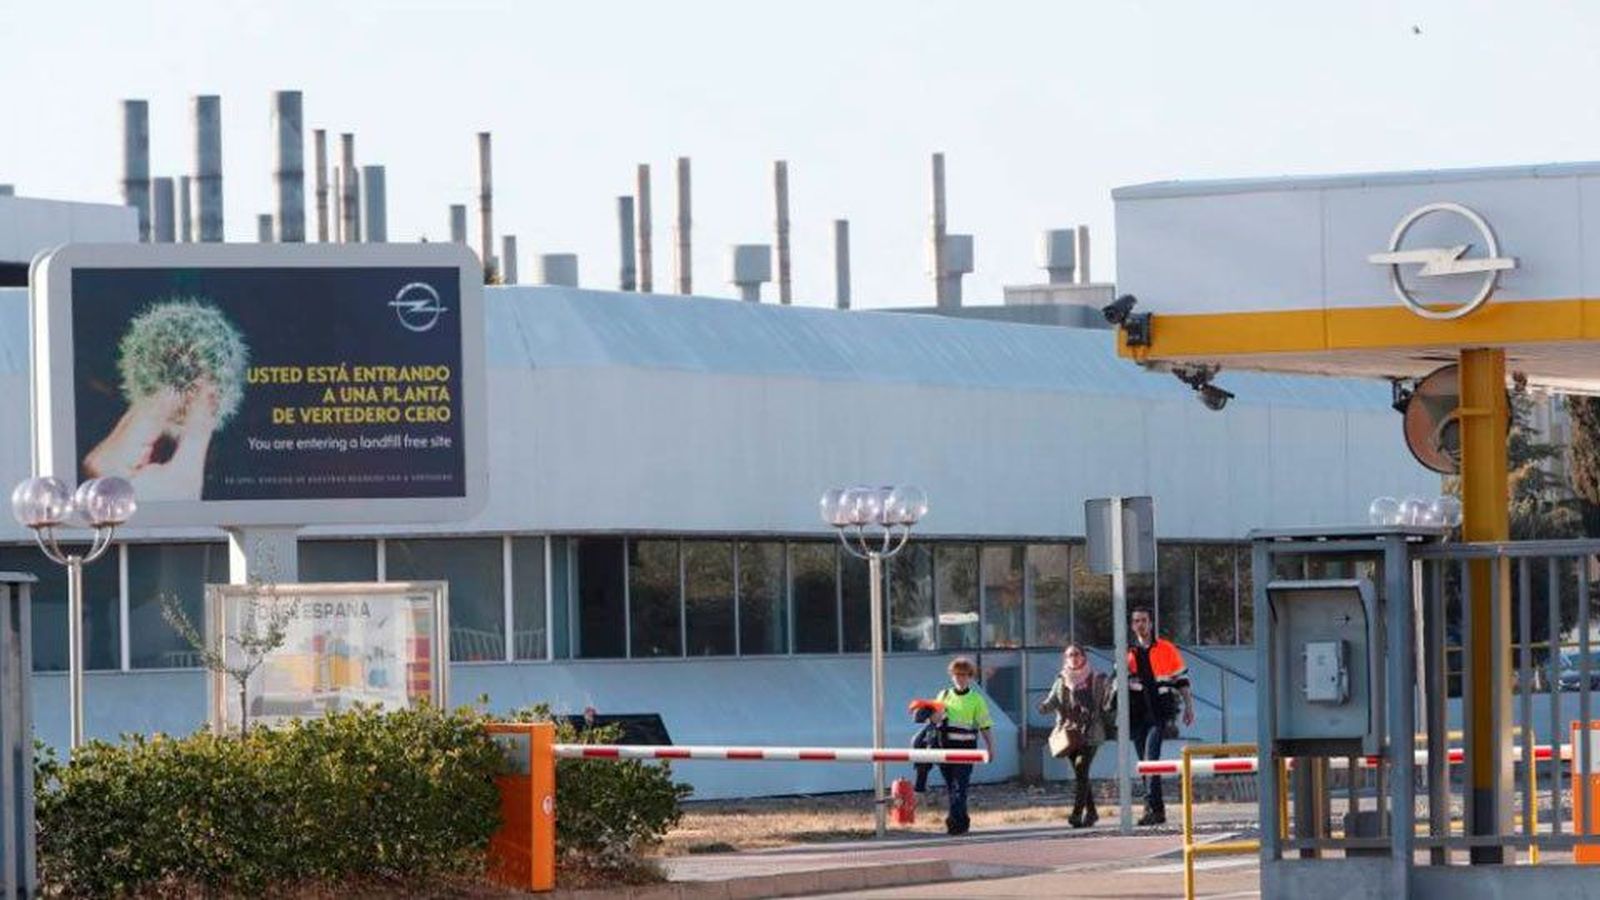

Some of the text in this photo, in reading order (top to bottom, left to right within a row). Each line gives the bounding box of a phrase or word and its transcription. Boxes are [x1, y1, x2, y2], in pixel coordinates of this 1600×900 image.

[248, 362, 450, 383] USTED ESTÁ ENTRANDO
[322, 386, 450, 403] A UNA PLANTA
[273, 406, 450, 424] DE VERTEDERO CERO
[248, 434, 452, 452] You are entering a landfill free site
